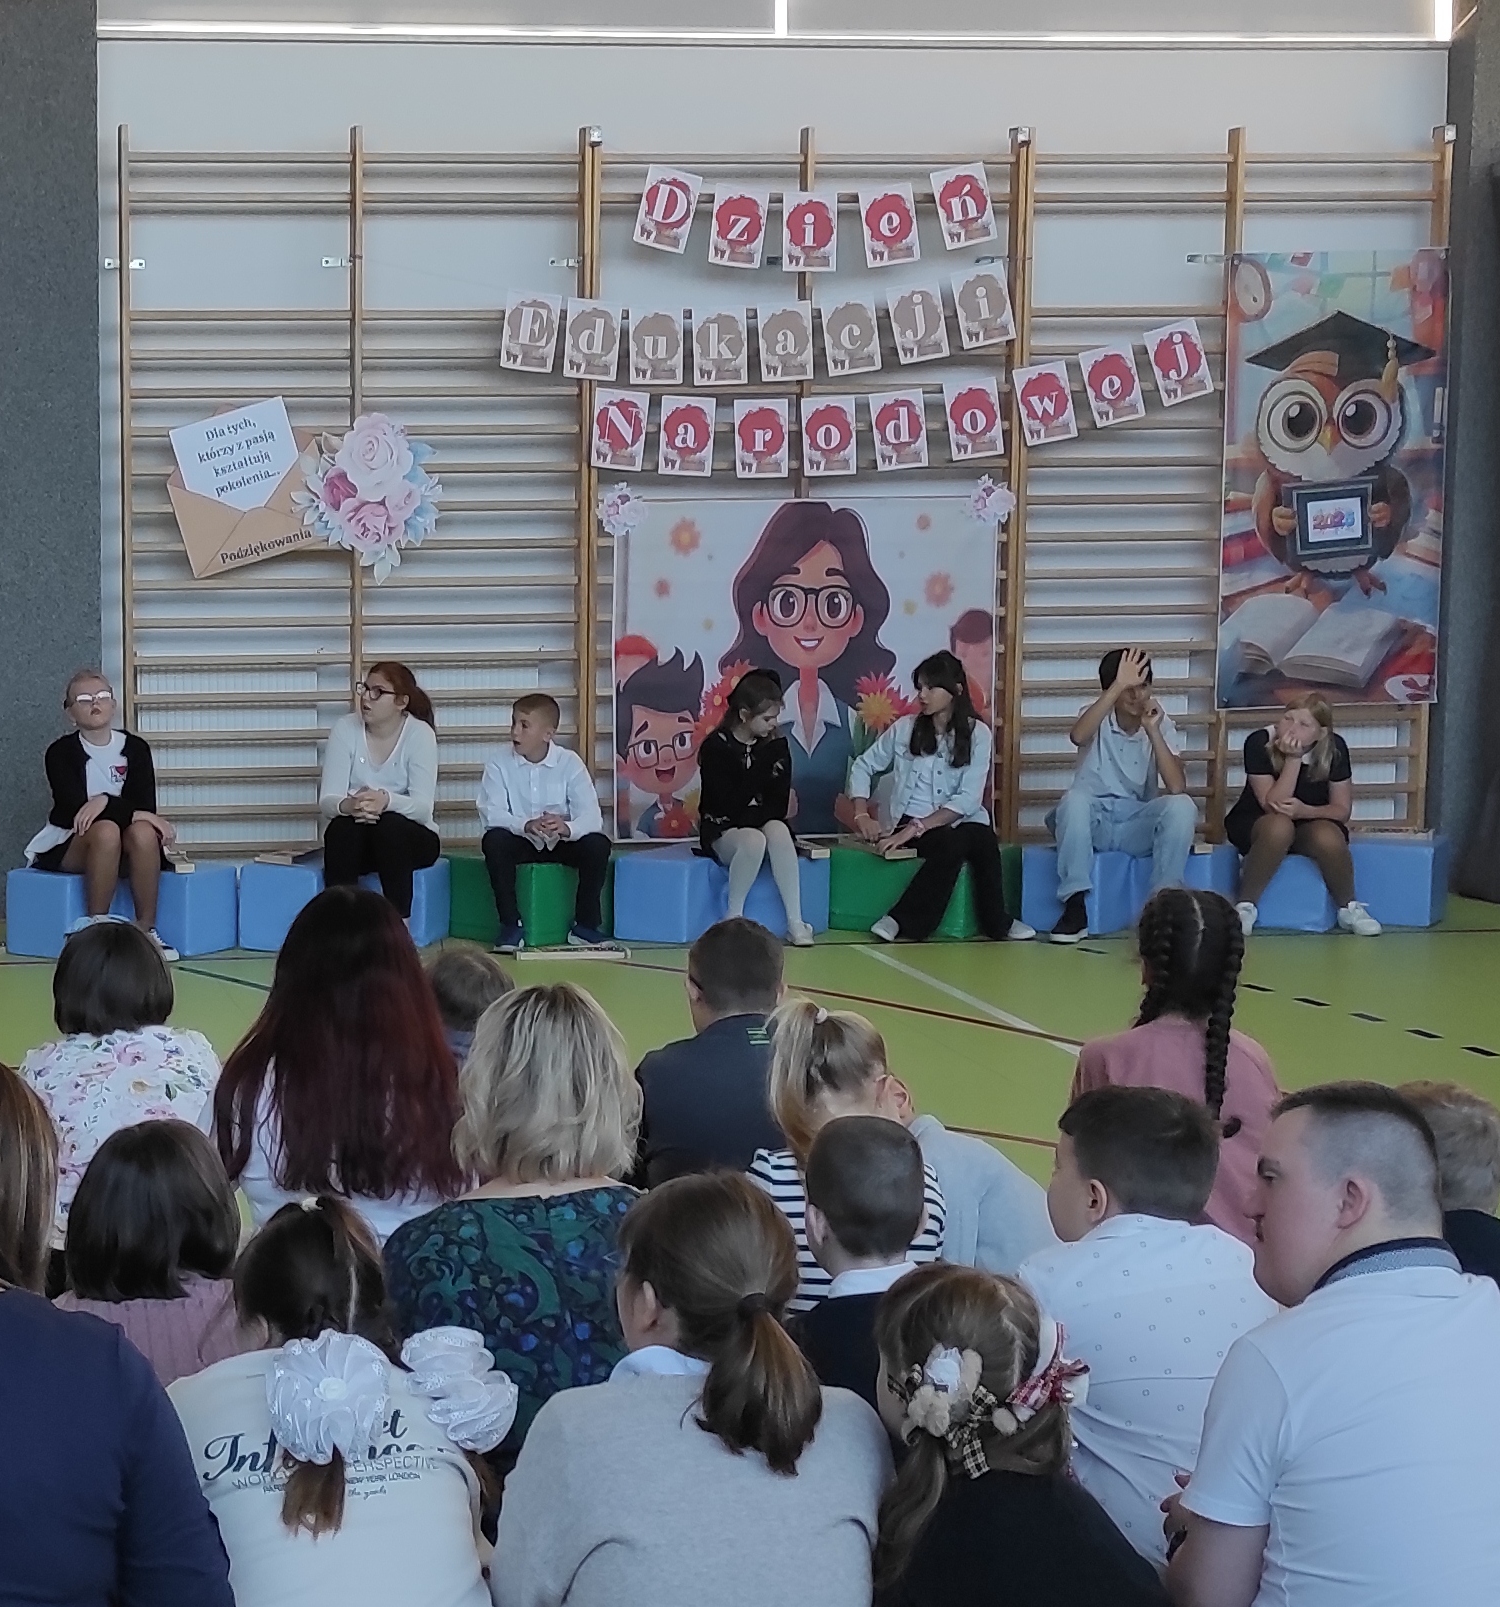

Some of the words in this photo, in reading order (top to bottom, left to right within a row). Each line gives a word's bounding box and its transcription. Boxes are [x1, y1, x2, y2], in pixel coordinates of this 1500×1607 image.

[645, 182, 979, 247] Dzień
[517, 286, 997, 361] Edukacji
[601, 333, 1190, 452] Narodowej
[197, 446, 235, 463] którzy
[236, 441, 245, 451] z
[244, 429, 276, 450] pasją
[205, 427, 226, 441] Dla
[227, 417, 257, 435] tych,
[212, 450, 272, 478] kształtują
[220, 528, 312, 564] Podziękowania
